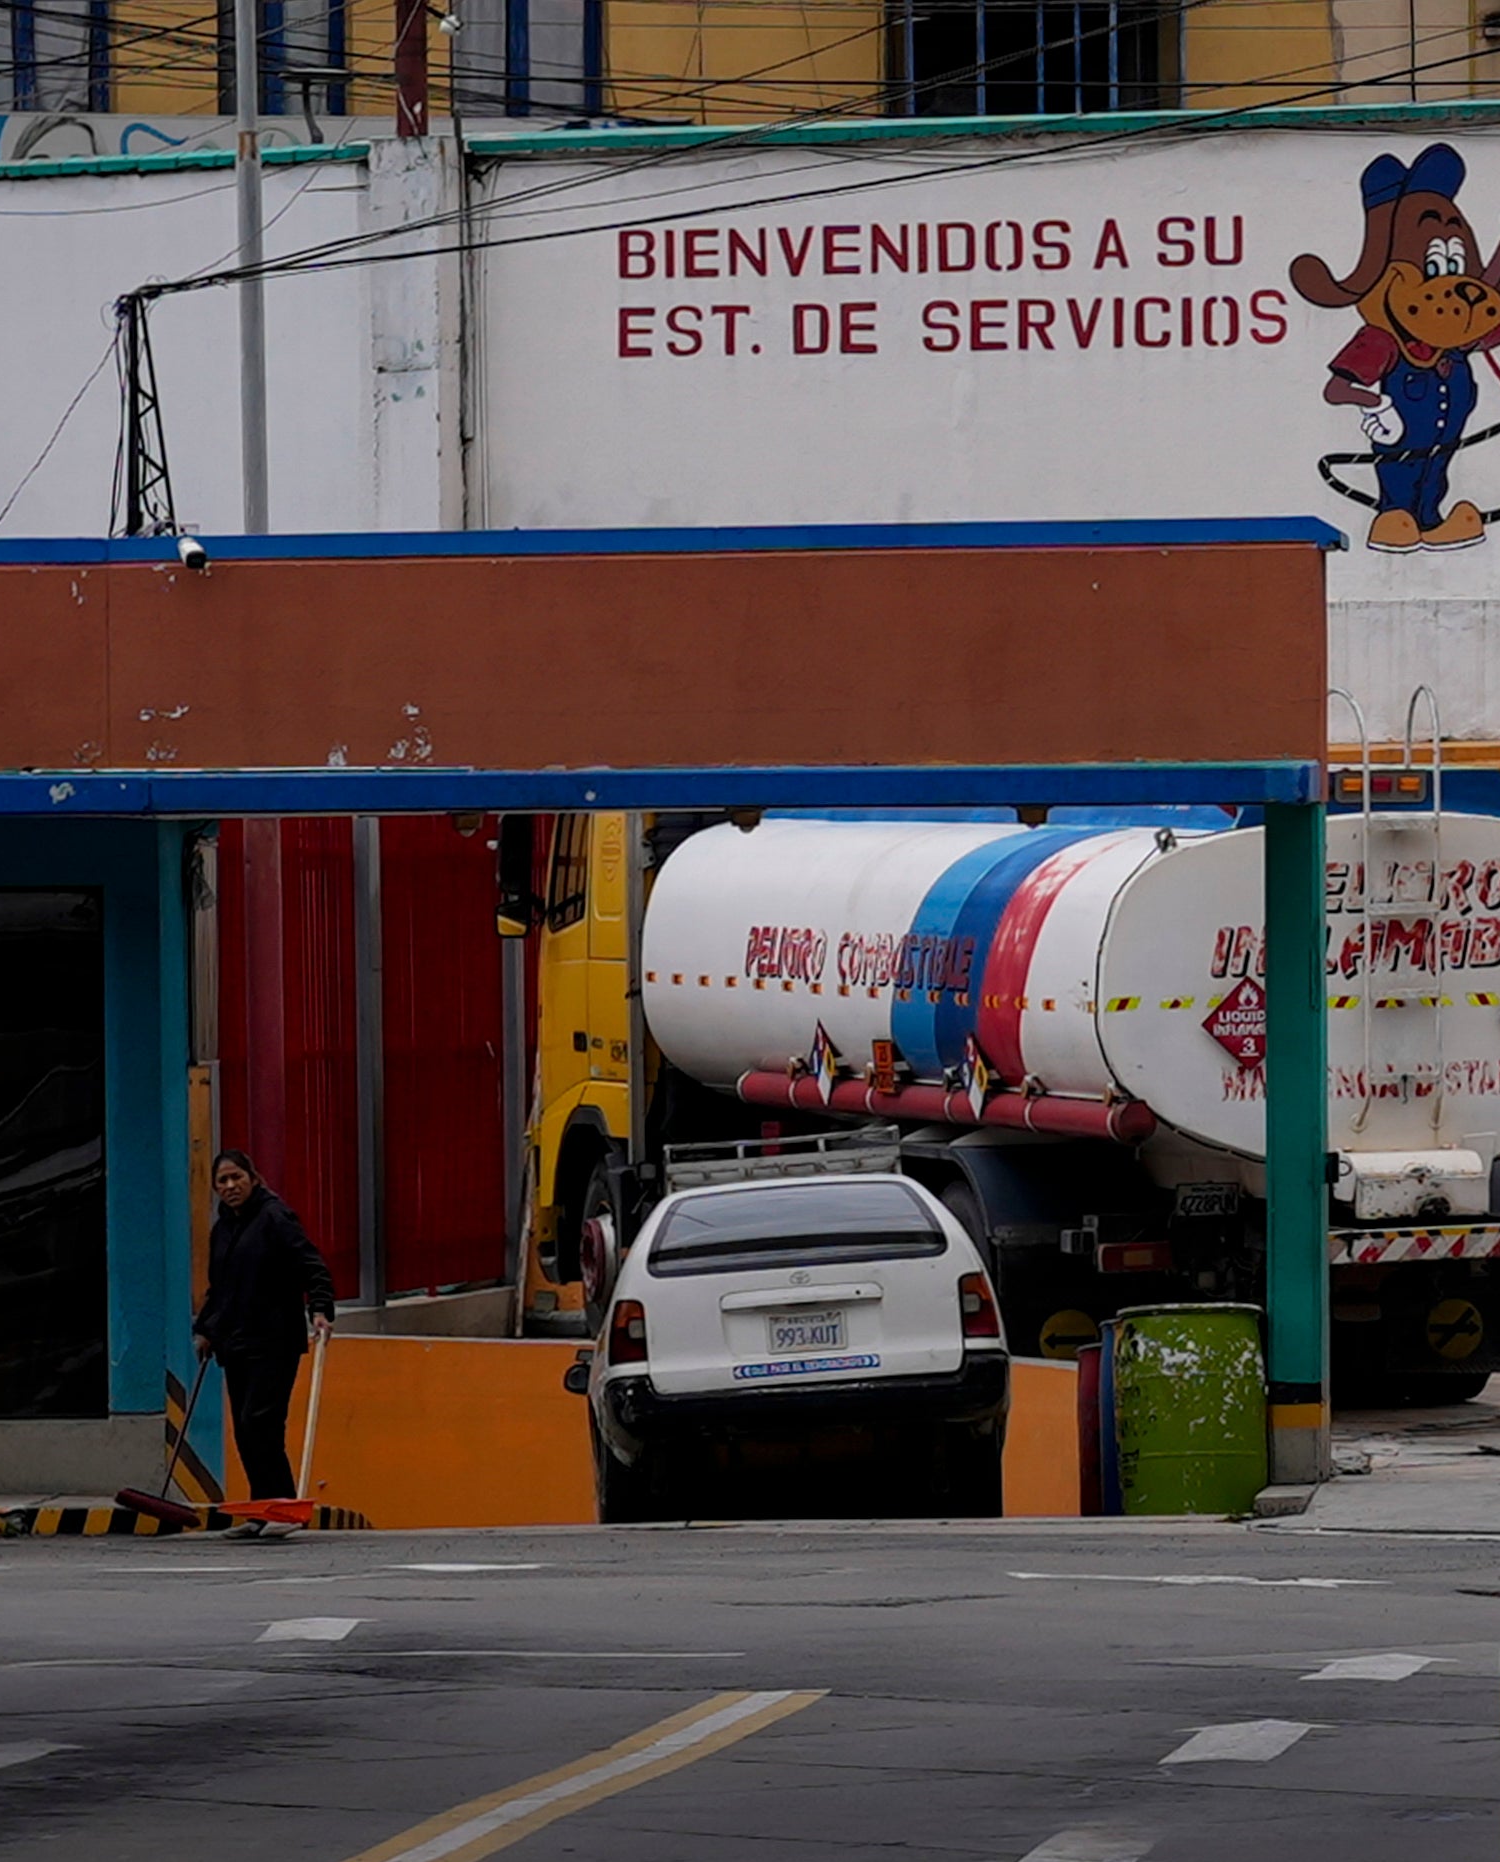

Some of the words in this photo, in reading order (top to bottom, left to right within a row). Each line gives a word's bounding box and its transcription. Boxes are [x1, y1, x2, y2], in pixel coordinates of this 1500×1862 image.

[618, 221, 1072, 279] BIENVENIDOS
[1093, 218, 1129, 270] A
[1157, 215, 1243, 269] SU
[618, 304, 762, 359] EST.
[793, 302, 878, 355] DE
[922, 290, 1289, 352] SERVICIOS
[746, 926, 827, 985] PELIGRO
[837, 932, 974, 992] COMBUSTIBLE
[1242, 1037, 1256, 1053] 3
